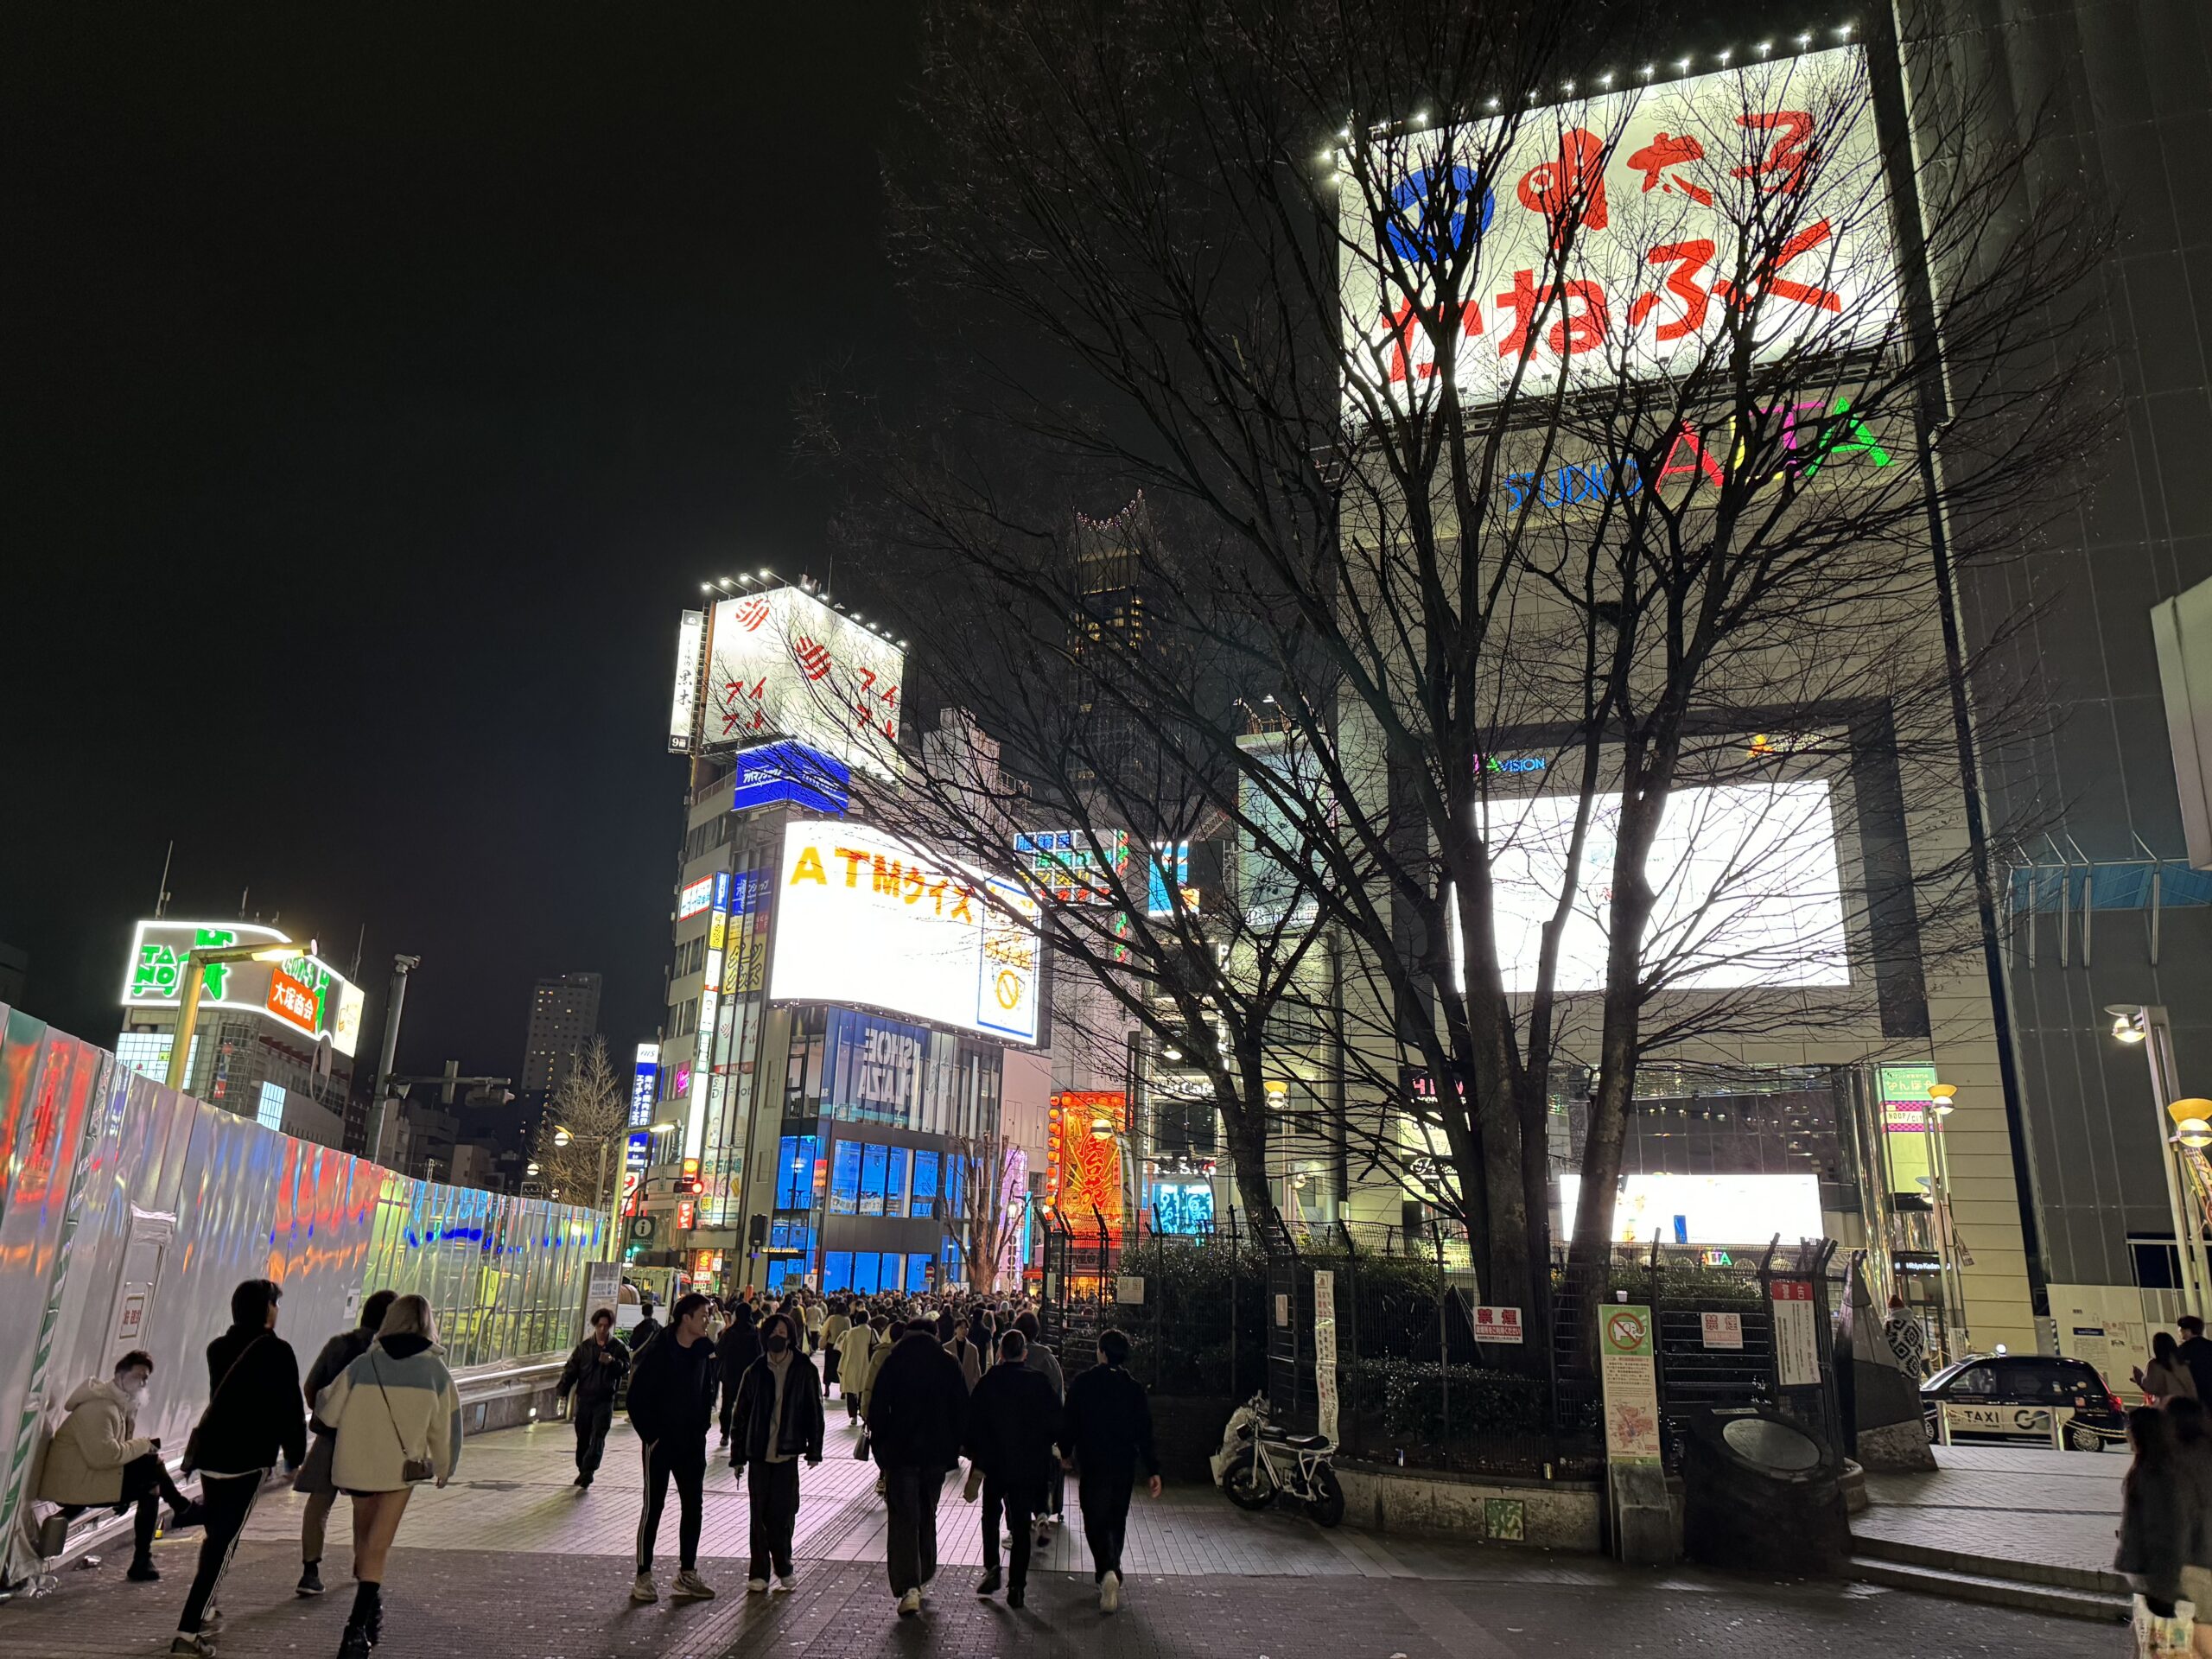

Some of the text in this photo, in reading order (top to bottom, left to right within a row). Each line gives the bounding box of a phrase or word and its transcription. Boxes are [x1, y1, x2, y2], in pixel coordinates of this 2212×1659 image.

[728, 942, 762, 969] ダーツ
[273, 982, 314, 1022] 大塚商会
[1965, 1410, 1999, 1423] TAXI
